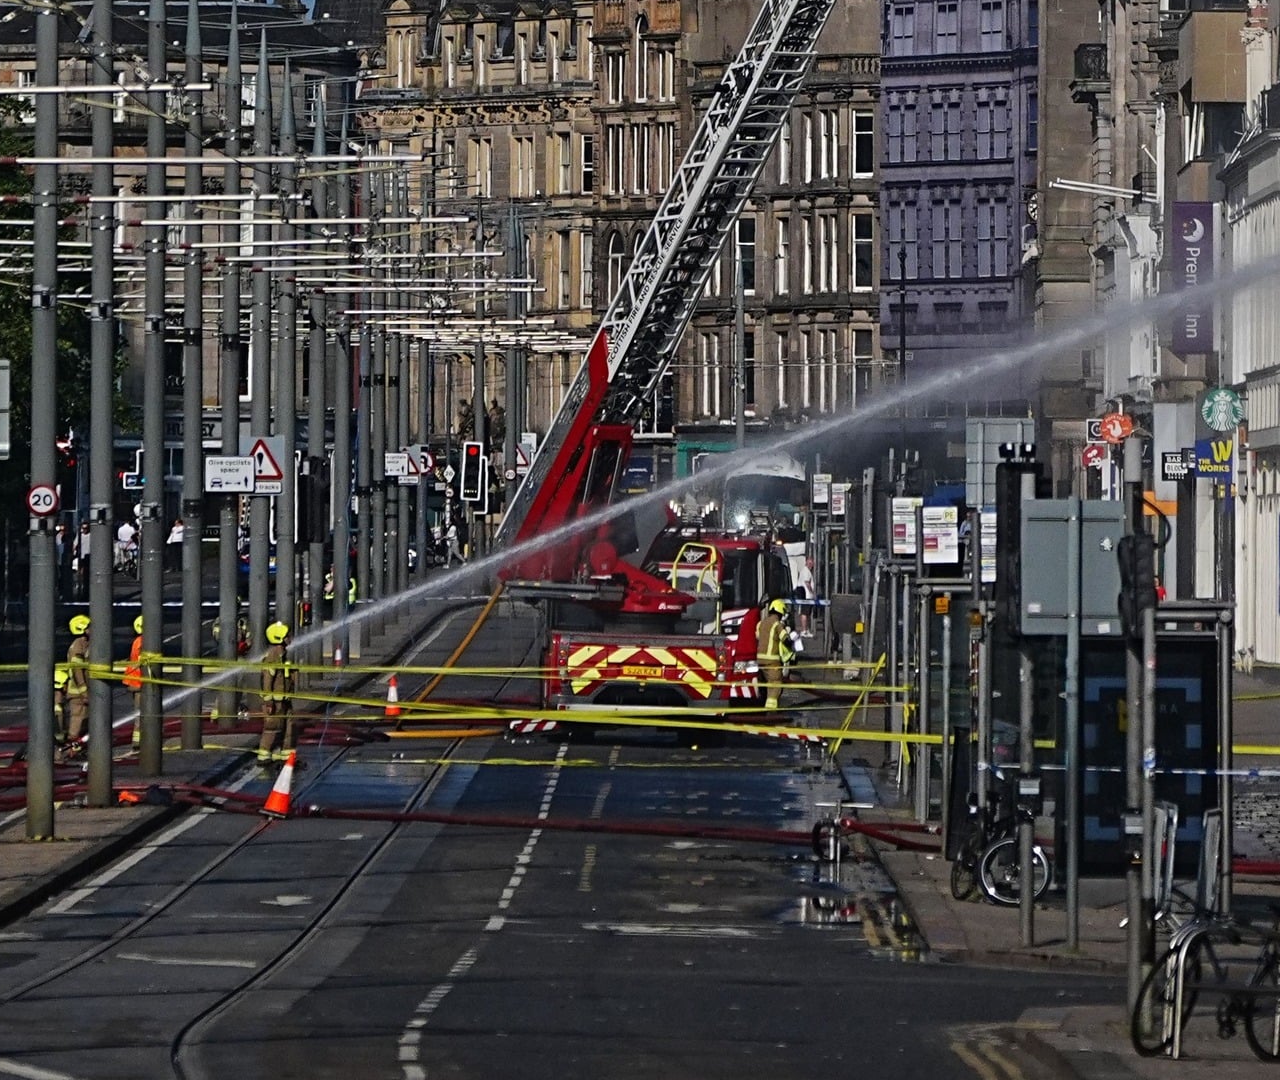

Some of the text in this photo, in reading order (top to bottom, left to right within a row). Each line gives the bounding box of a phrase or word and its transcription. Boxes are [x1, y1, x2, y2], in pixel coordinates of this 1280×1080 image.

[608, 322, 630, 365] SCOTTISH
[629, 304, 640, 324] FIRE
[639, 286, 650, 305] AND
[1198, 465, 1230, 473] WORKS
[32, 494, 53, 507] 20
